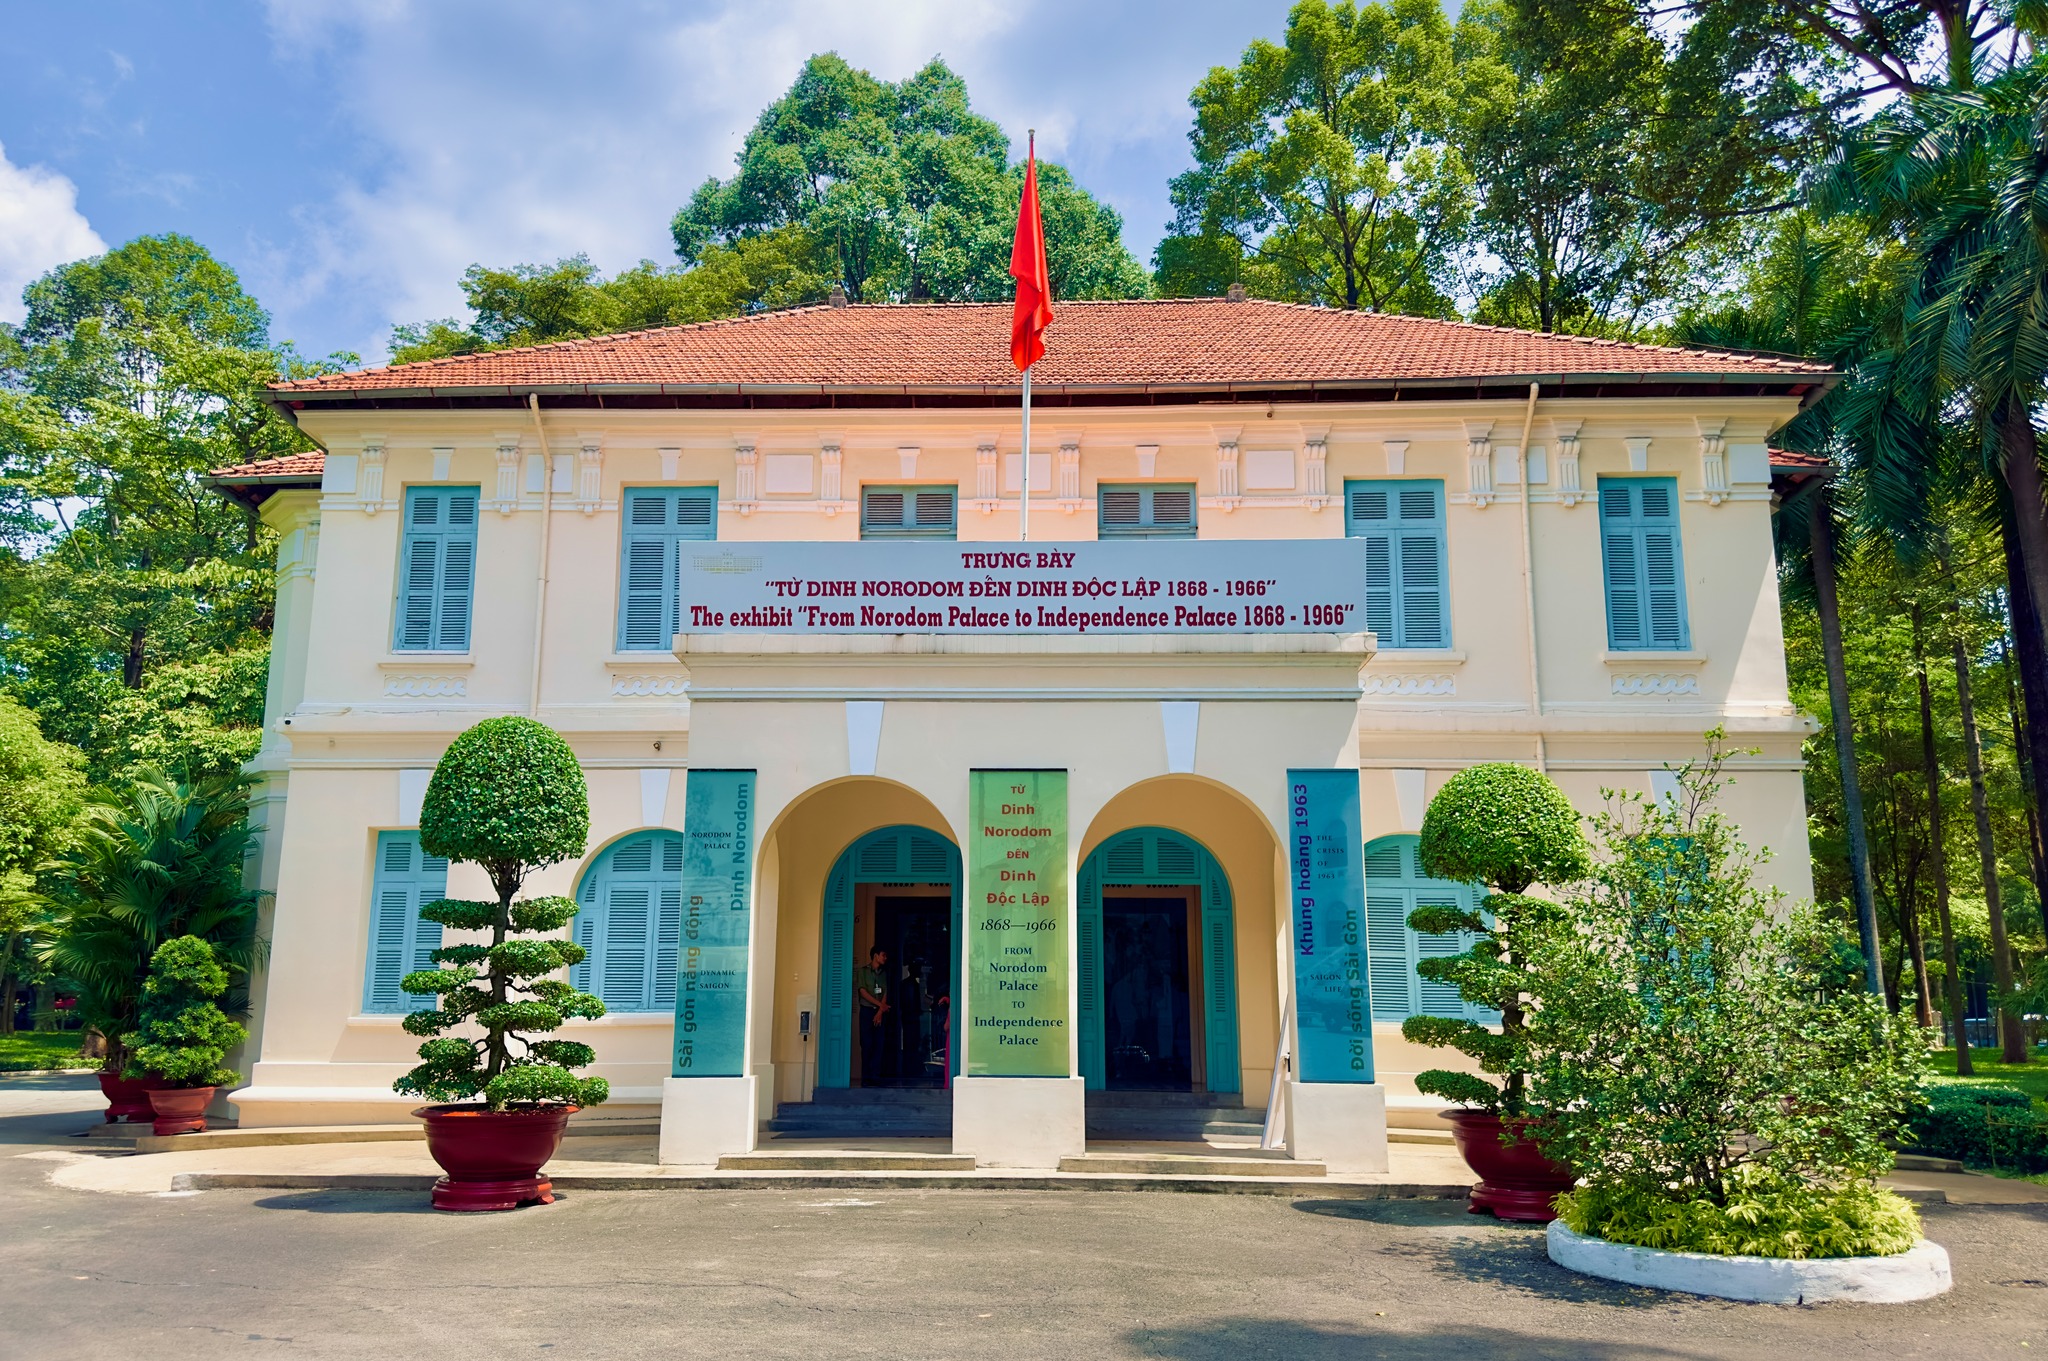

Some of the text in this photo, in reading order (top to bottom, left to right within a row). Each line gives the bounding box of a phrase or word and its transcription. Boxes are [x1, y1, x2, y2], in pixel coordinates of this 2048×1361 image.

[961, 548, 1076, 568] TRƯNG BÀY
[807, 581, 857, 597] DINH
[862, 580, 964, 597] NORODOM
[969, 575, 1012, 597] ĐẾN
[1017, 580, 1067, 597] DINH
[1072, 577, 1117, 600] ĐỘC
[1122, 576, 1161, 600] LẬP
[1168, 580, 1208, 597] 1868
[690, 605, 724, 627] The
[730, 605, 793, 627] exhibit
[860, 605, 943, 627] Norodom
[948, 605, 1009, 627] Palace
[1015, 608, 1032, 627] to
[1037, 605, 1169, 632] Independence
[1174, 605, 1237, 627] Palace
[1244, 605, 1285, 626] 1868
[1010, 783, 1026, 794] TỪ
[1001, 803, 1035, 815] Dinh
[1293, 783, 1309, 828] 1963
[984, 826, 1052, 837] Norodom
[730, 783, 749, 911] Dinh Norodom
[1006, 848, 1029, 859] ĐẾN
[1000, 870, 1036, 881] Dinh
[986, 891, 1050, 907] Độc Lập
[1298, 897, 1315, 956] Khủng
[1004, 947, 1032, 955] FROM
[989, 962, 1047, 973] Norodom
[678, 895, 703, 1068] Sài gòn năng động
[999, 980, 1038, 991] Palace
[1342, 909, 1365, 1071] Đời sống Sài Gòn
[1011, 1001, 1025, 1009] TO
[974, 1016, 1064, 1029] Independence
[999, 1034, 1039, 1045] Palace
